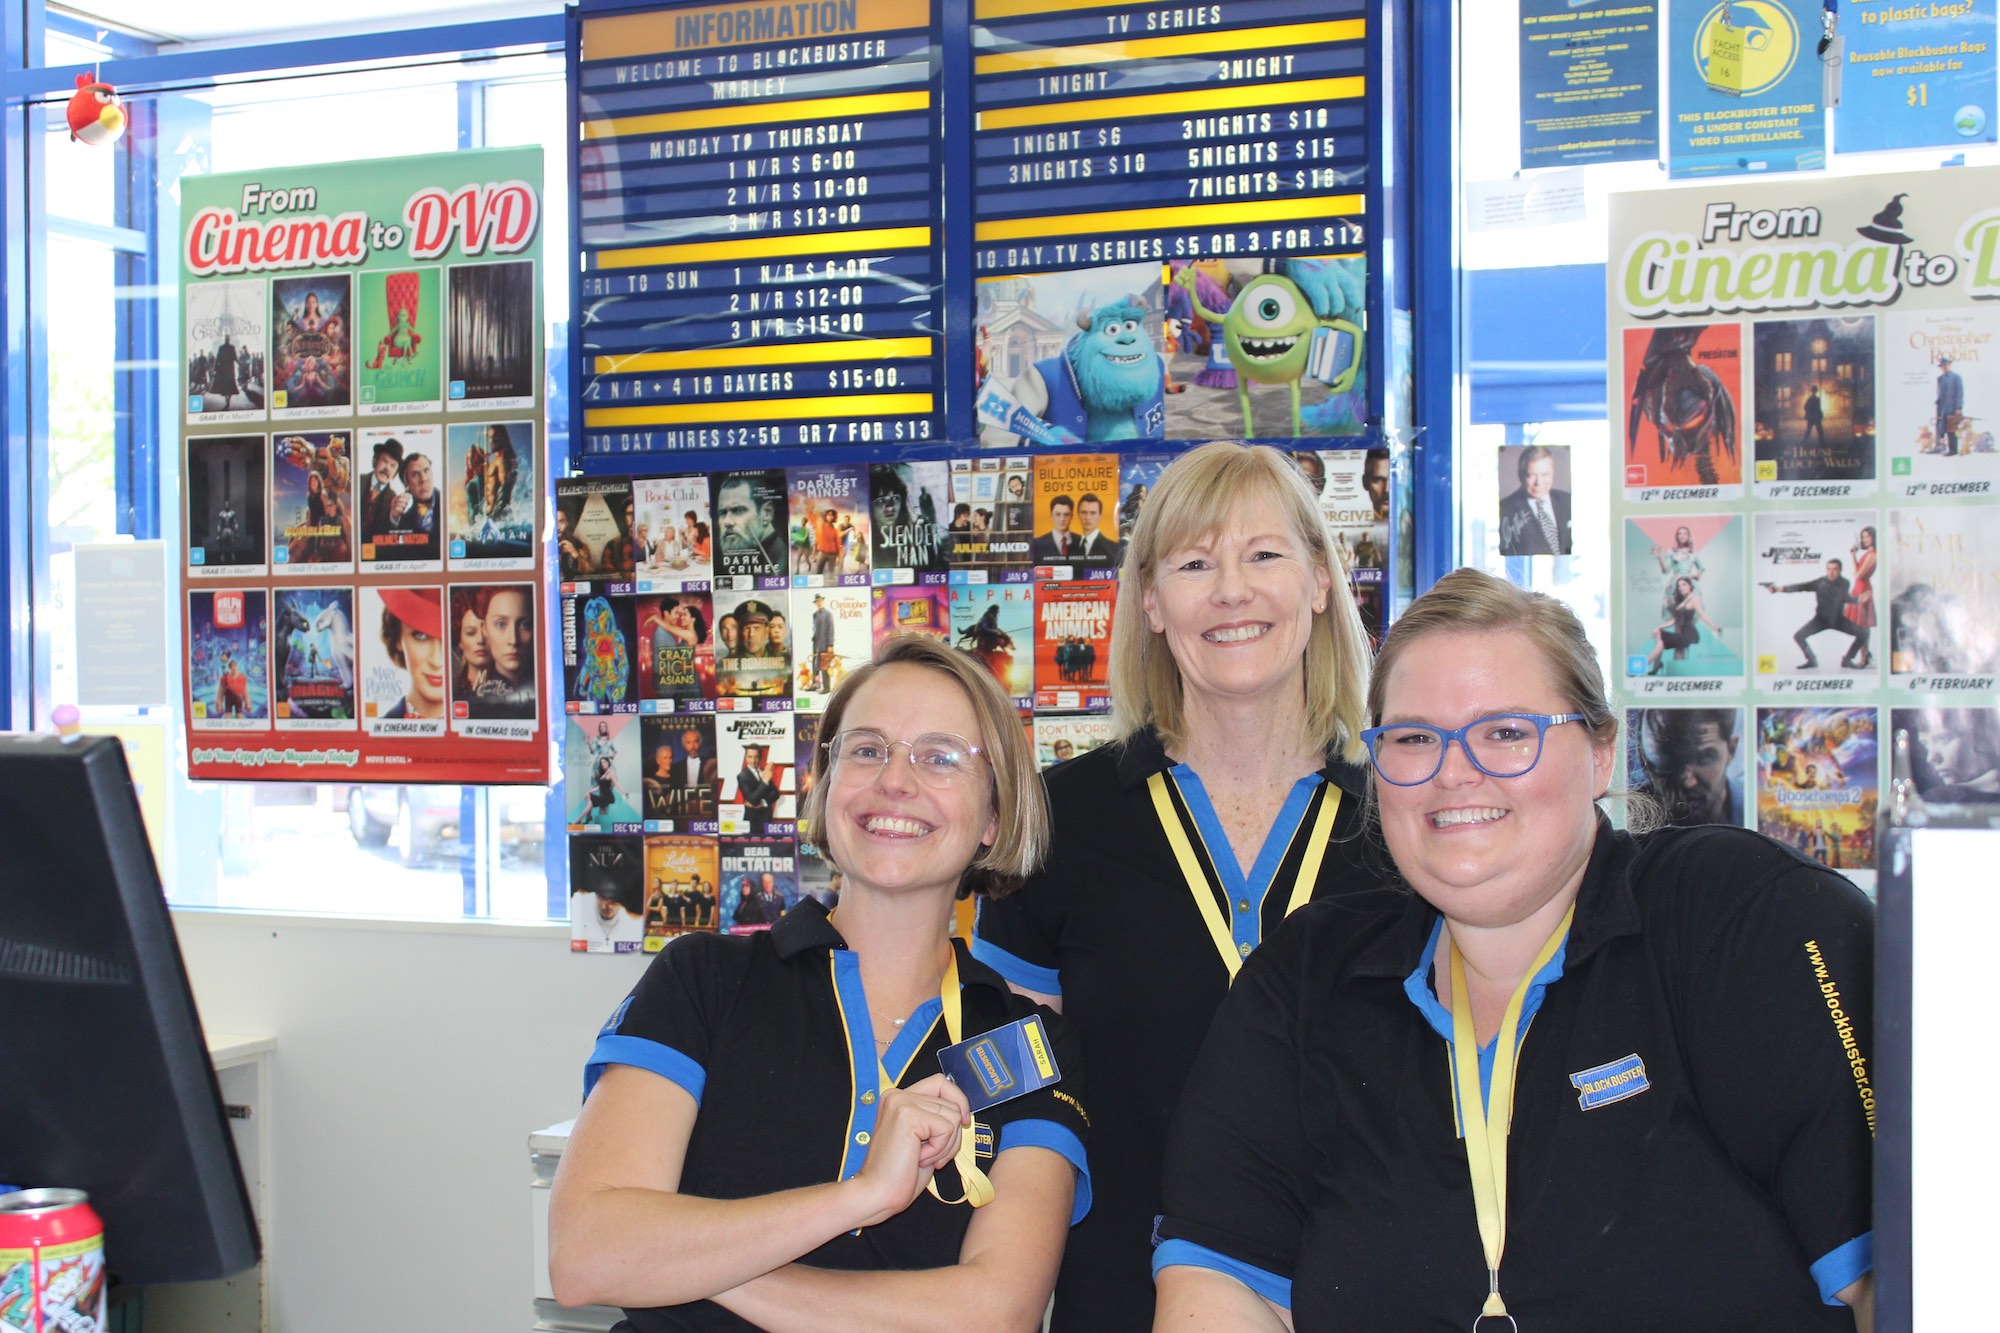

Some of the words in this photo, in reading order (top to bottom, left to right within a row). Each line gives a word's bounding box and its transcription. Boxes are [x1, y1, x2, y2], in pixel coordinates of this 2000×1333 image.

[1107, 14, 1130, 34] TV
[1148, 5, 1223, 31] SERIES
[1862, 11, 1877, 24] to
[1880, 4, 1928, 26] plastic
[1930, 0, 1974, 19] bags?
[675, 2, 857, 48] INFORMATION
[1713, 39, 1741, 51] YACHT
[1850, 48, 1896, 63] Reusable
[1897, 44, 1958, 59] Blockbuster
[1960, 41, 1987, 54] Bags
[616, 60, 702, 83] WELCOME
[718, 56, 738, 73] TO
[753, 40, 886, 70] BLOCKBUSTER
[1712, 50, 1740, 62] ACCESS
[1720, 67, 1730, 78] 16
[1872, 67, 1894, 77] now
[1897, 61, 1946, 75] available
[1947, 59, 1963, 70] for
[1906, 83, 1928, 107] $1
[1678, 114, 1701, 122] THIS
[1704, 107, 1778, 121] BLOCKBUSTER
[1781, 104, 1816, 115] STORE
[1694, 125, 1705, 134] IS
[1708, 121, 1743, 132] UNDER
[1745, 117, 1800, 130] CONSTANT
[650, 136, 721, 160] MONDAY
[732, 133, 752, 151] TO
[768, 122, 864, 149] THURSDAY
[1098, 126, 1121, 147] $6
[1689, 137, 1721, 147] VIDEO
[1723, 131, 1804, 144] SURVEILLANCE.
[1295, 138, 1335, 159] $15
[728, 162, 735, 180] 1
[748, 158, 781, 180] N/R
[1109, 153, 1146, 174] $10
[241, 183, 318, 215] From
[728, 188, 737, 206] 2
[748, 184, 781, 206] N/R
[187, 210, 365, 271] Cinema
[371, 221, 405, 249] to
[407, 184, 535, 252] DVD
[728, 215, 737, 232] 3
[748, 210, 782, 232] N/R
[1703, 202, 1820, 242] From
[628, 274, 648, 292] TO
[666, 270, 699, 290] SUN
[734, 267, 741, 284] 1
[760, 262, 794, 283] N/R
[1622, 236, 1890, 309] Cinema
[1904, 251, 1957, 287] to
[730, 293, 739, 312] 2
[750, 289, 783, 312] N/R
[731, 321, 741, 339] 3
[751, 315, 785, 338] N/R
[592, 382, 600, 401] 2
[611, 377, 642, 398] N/R
[672, 377, 681, 396] 4
[693, 375, 713, 395] 10
[724, 372, 794, 393] DAYERS
[592, 435, 610, 453] 10
[621, 430, 654, 452] DAY
[667, 428, 720, 450] HIRES
[799, 423, 821, 445] OR
[828, 423, 838, 442] 7
[848, 420, 884, 442] FOR
[894, 418, 931, 440] $13
[1040, 466, 1113, 480] BILLIONAIRE
[797, 478, 858, 490] DARKEST
[806, 487, 850, 497] MINDS
[1044, 481, 1073, 492] BOYS
[1077, 480, 1108, 491] CLUB
[1769, 485, 1790, 498] 19TH
[1793, 485, 1851, 497] DECEMBER
[1906, 483, 1926, 496] 12TH
[1930, 481, 1991, 495] DECEMBER
[645, 490, 672, 503] Book
[673, 488, 699, 500] Club
[1640, 487, 1660, 501] 12TH
[1663, 487, 1719, 500] DECEMBER
[880, 519, 940, 555] SLENDER
[896, 545, 929, 567] MAN
[990, 541, 1030, 553] NAKED
[1089, 571, 1104, 580] JAN
[1106, 570, 1112, 580] 9
[687, 582, 700, 591] DEC
[701, 581, 707, 591] 5
[1041, 600, 1110, 621] AMERICAN
[1045, 619, 1107, 640] ANIMALS
[658, 649, 694, 661] CRAZY
[723, 658, 739, 671] THE
[741, 656, 785, 670] BOMBING
[659, 660, 694, 675] RICH
[659, 675, 695, 685] ASIANS
[1644, 680, 1664, 692] 12TH
[1666, 680, 1724, 691] DECEMBER
[1773, 679, 1793, 692] 19TH
[1796, 679, 1854, 691] DECEMBER
[1909, 678, 1926, 690] 6TH
[1930, 678, 1995, 690] FEBRUARY
[689, 702, 703, 711] DEC
[703, 701, 714, 710] 12
[373, 723, 381, 732] IN
[384, 723, 418, 732] CINEMAS
[420, 723, 438, 732] NOW
[465, 725, 473, 734] IN
[475, 726, 509, 735] CINEMAS
[510, 727, 529, 736] SOON
[726, 719, 775, 733] JOHNNY
[738, 727, 786, 740] ENGLISH
[192, 748, 213, 764] Grab
[214, 748, 234, 763] Your
[234, 748, 256, 766] Copy
[256, 748, 267, 766] of
[267, 749, 284, 762] Our
[285, 749, 325, 766] Magazine
[325, 748, 360, 766] Today!
[648, 787, 712, 815] WIFE
[744, 847, 770, 857] DEAR
[721, 857, 794, 872] DICTATOR
[1033, 1038, 1047, 1066] SARAH
[975, 1044, 1001, 1086] BLOCKBUSTER
[1584, 1065, 1644, 1094] BLOCKBUSTER
